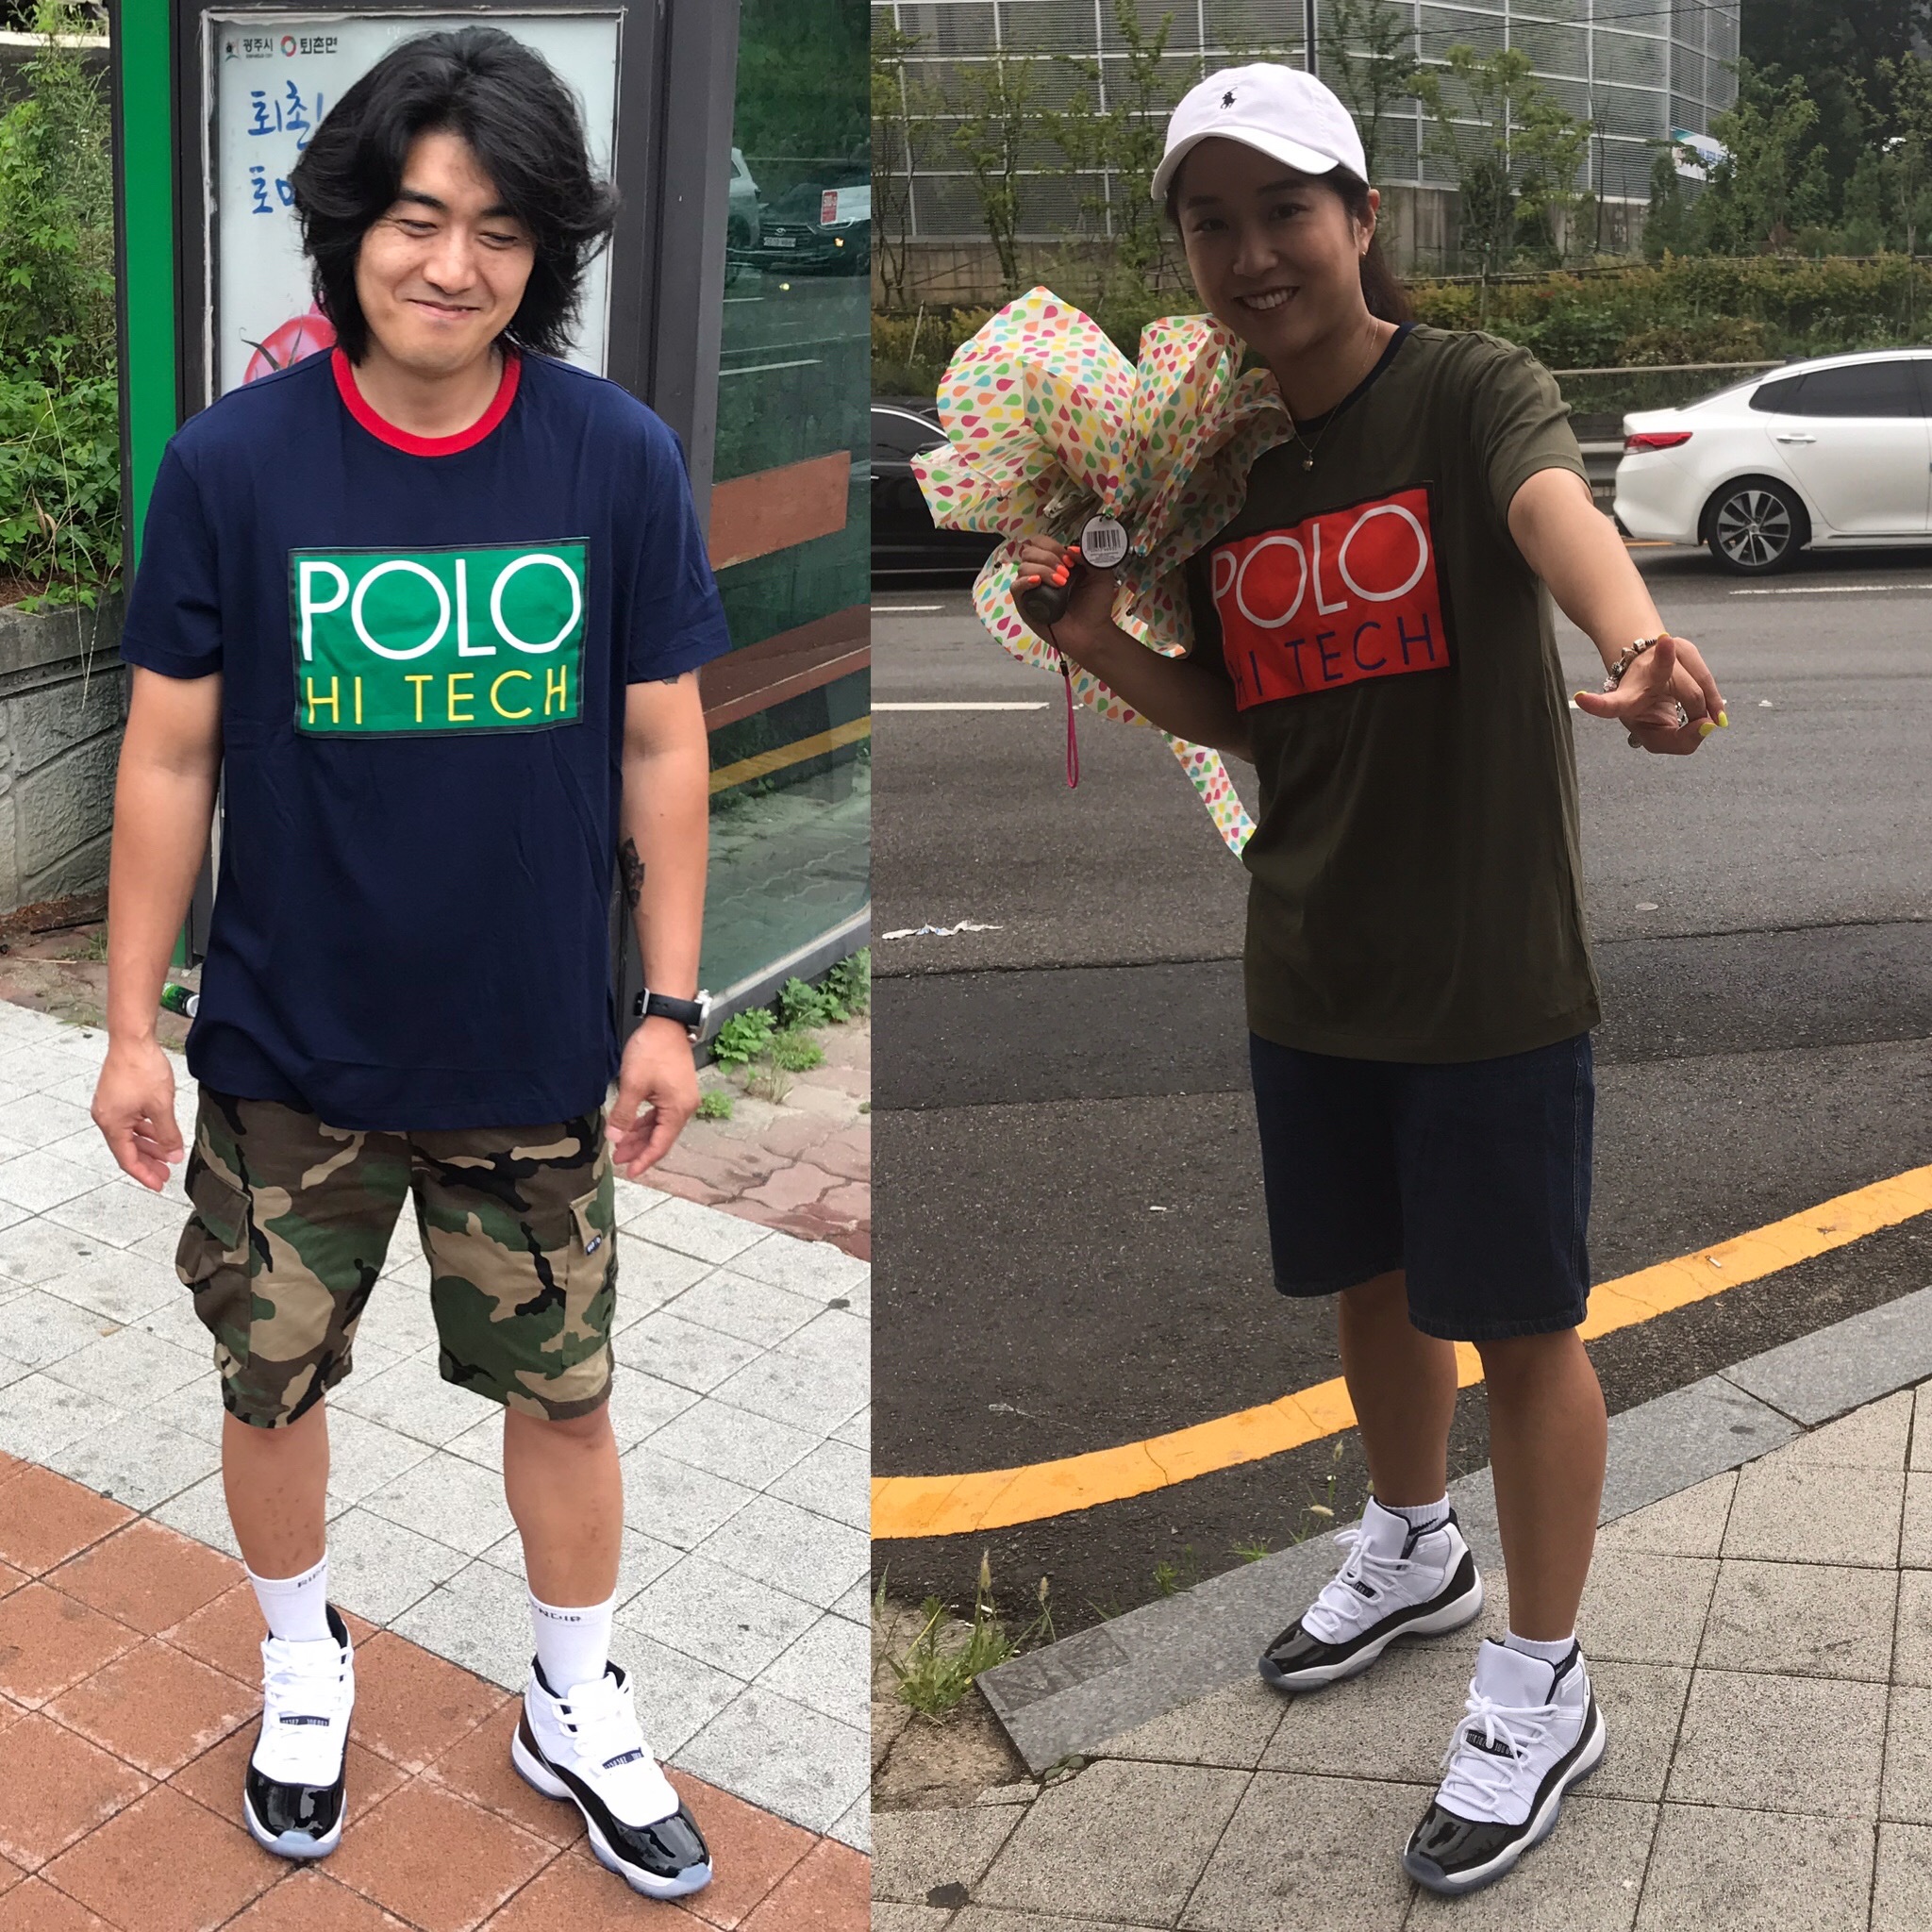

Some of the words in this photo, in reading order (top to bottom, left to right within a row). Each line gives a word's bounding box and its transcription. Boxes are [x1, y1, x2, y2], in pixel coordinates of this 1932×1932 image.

[242, 38, 274, 52] 광주시
[299, 36, 339, 55] 퇴촌면
[299, 553, 582, 661] POLO
[1211, 504, 1429, 645] POLO
[1284, 613, 1436, 689] TECH
[307, 675, 362, 724] HI
[404, 664, 567, 724] TECH
